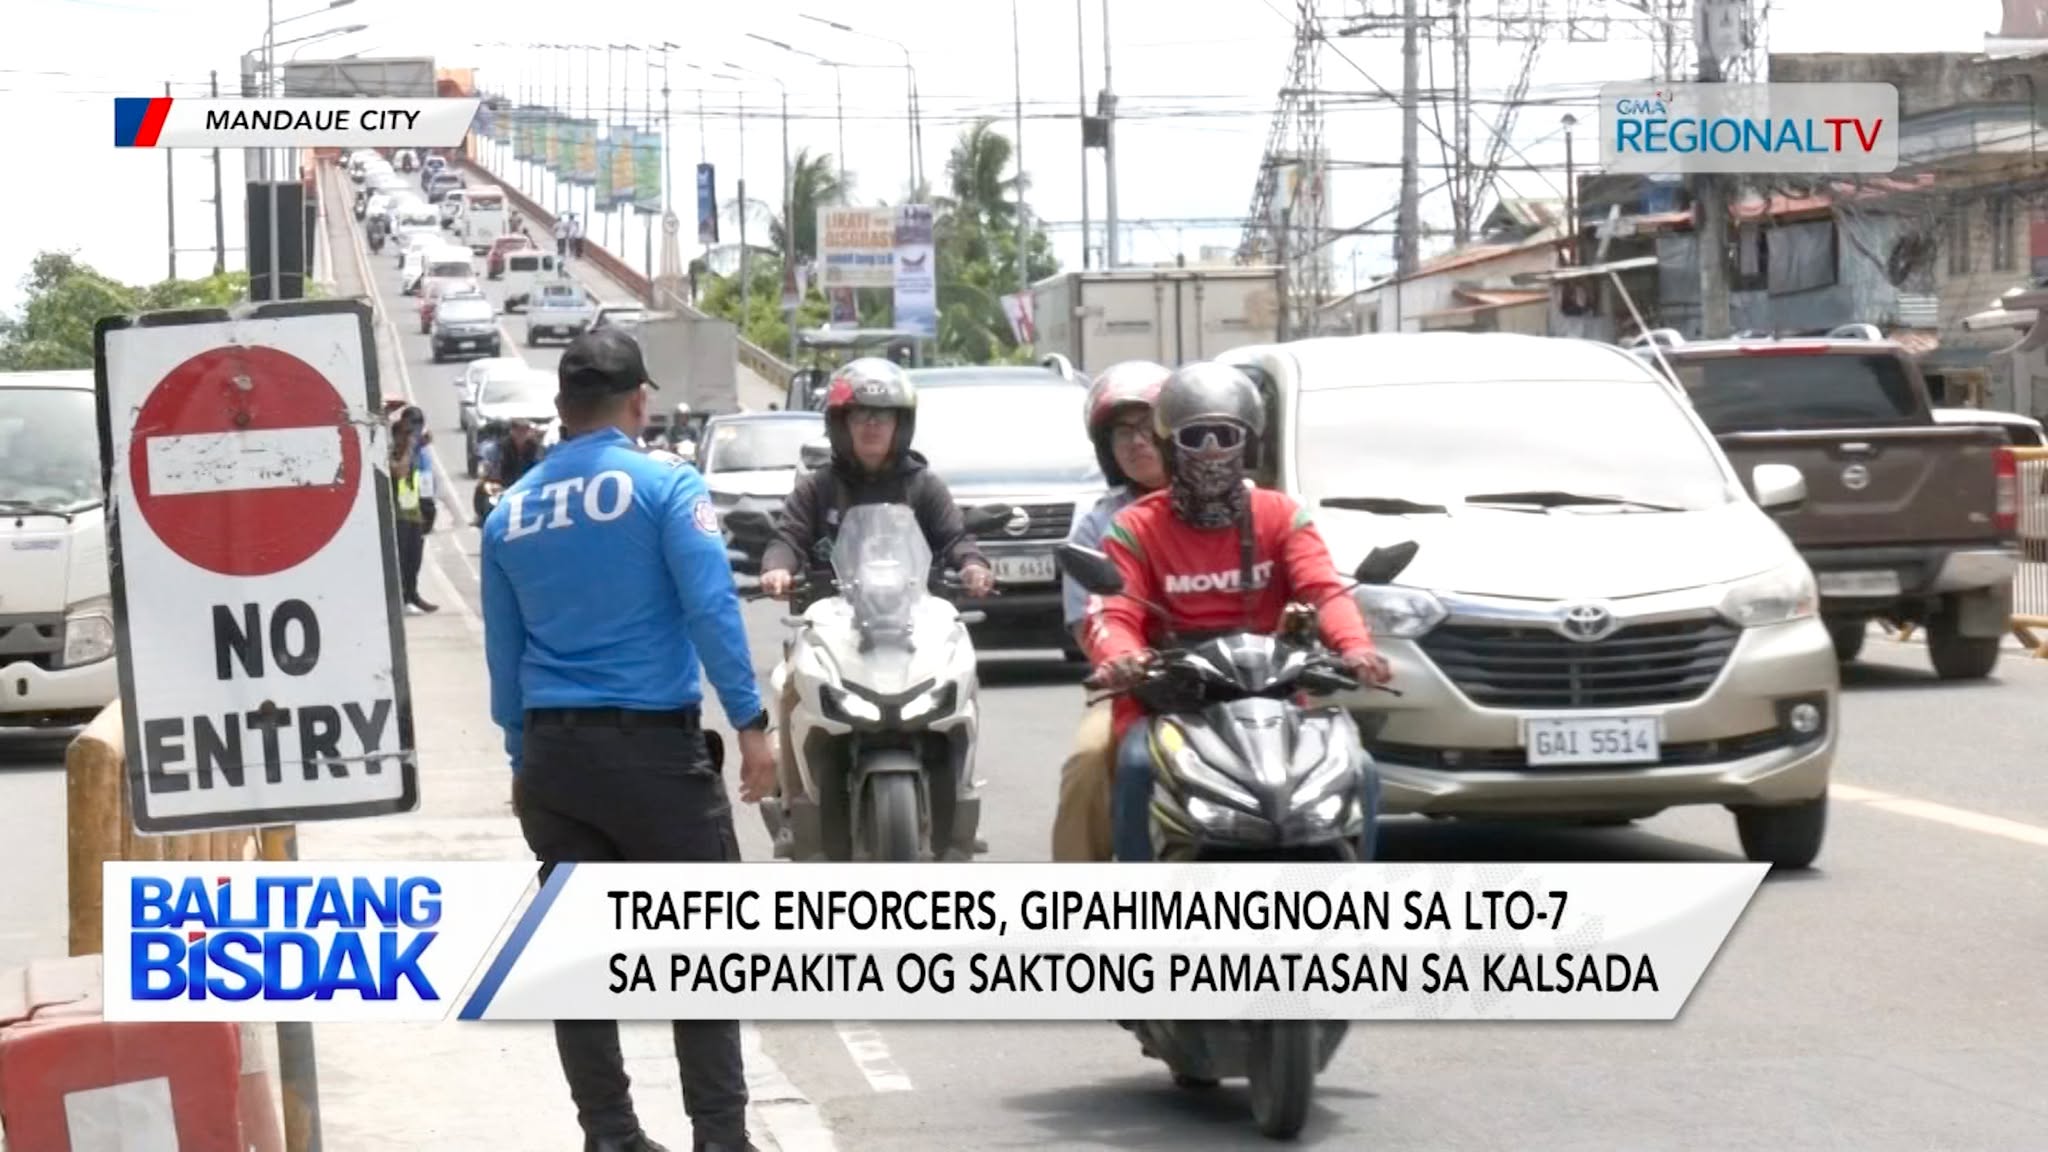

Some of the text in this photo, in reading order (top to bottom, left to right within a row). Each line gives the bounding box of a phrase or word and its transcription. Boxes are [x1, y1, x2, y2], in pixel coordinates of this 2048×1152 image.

[503, 470, 633, 542] LTO
[212, 598, 321, 681] NO
[144, 699, 393, 794] ENTRY
[1536, 728, 1648, 756] GAI 5514
